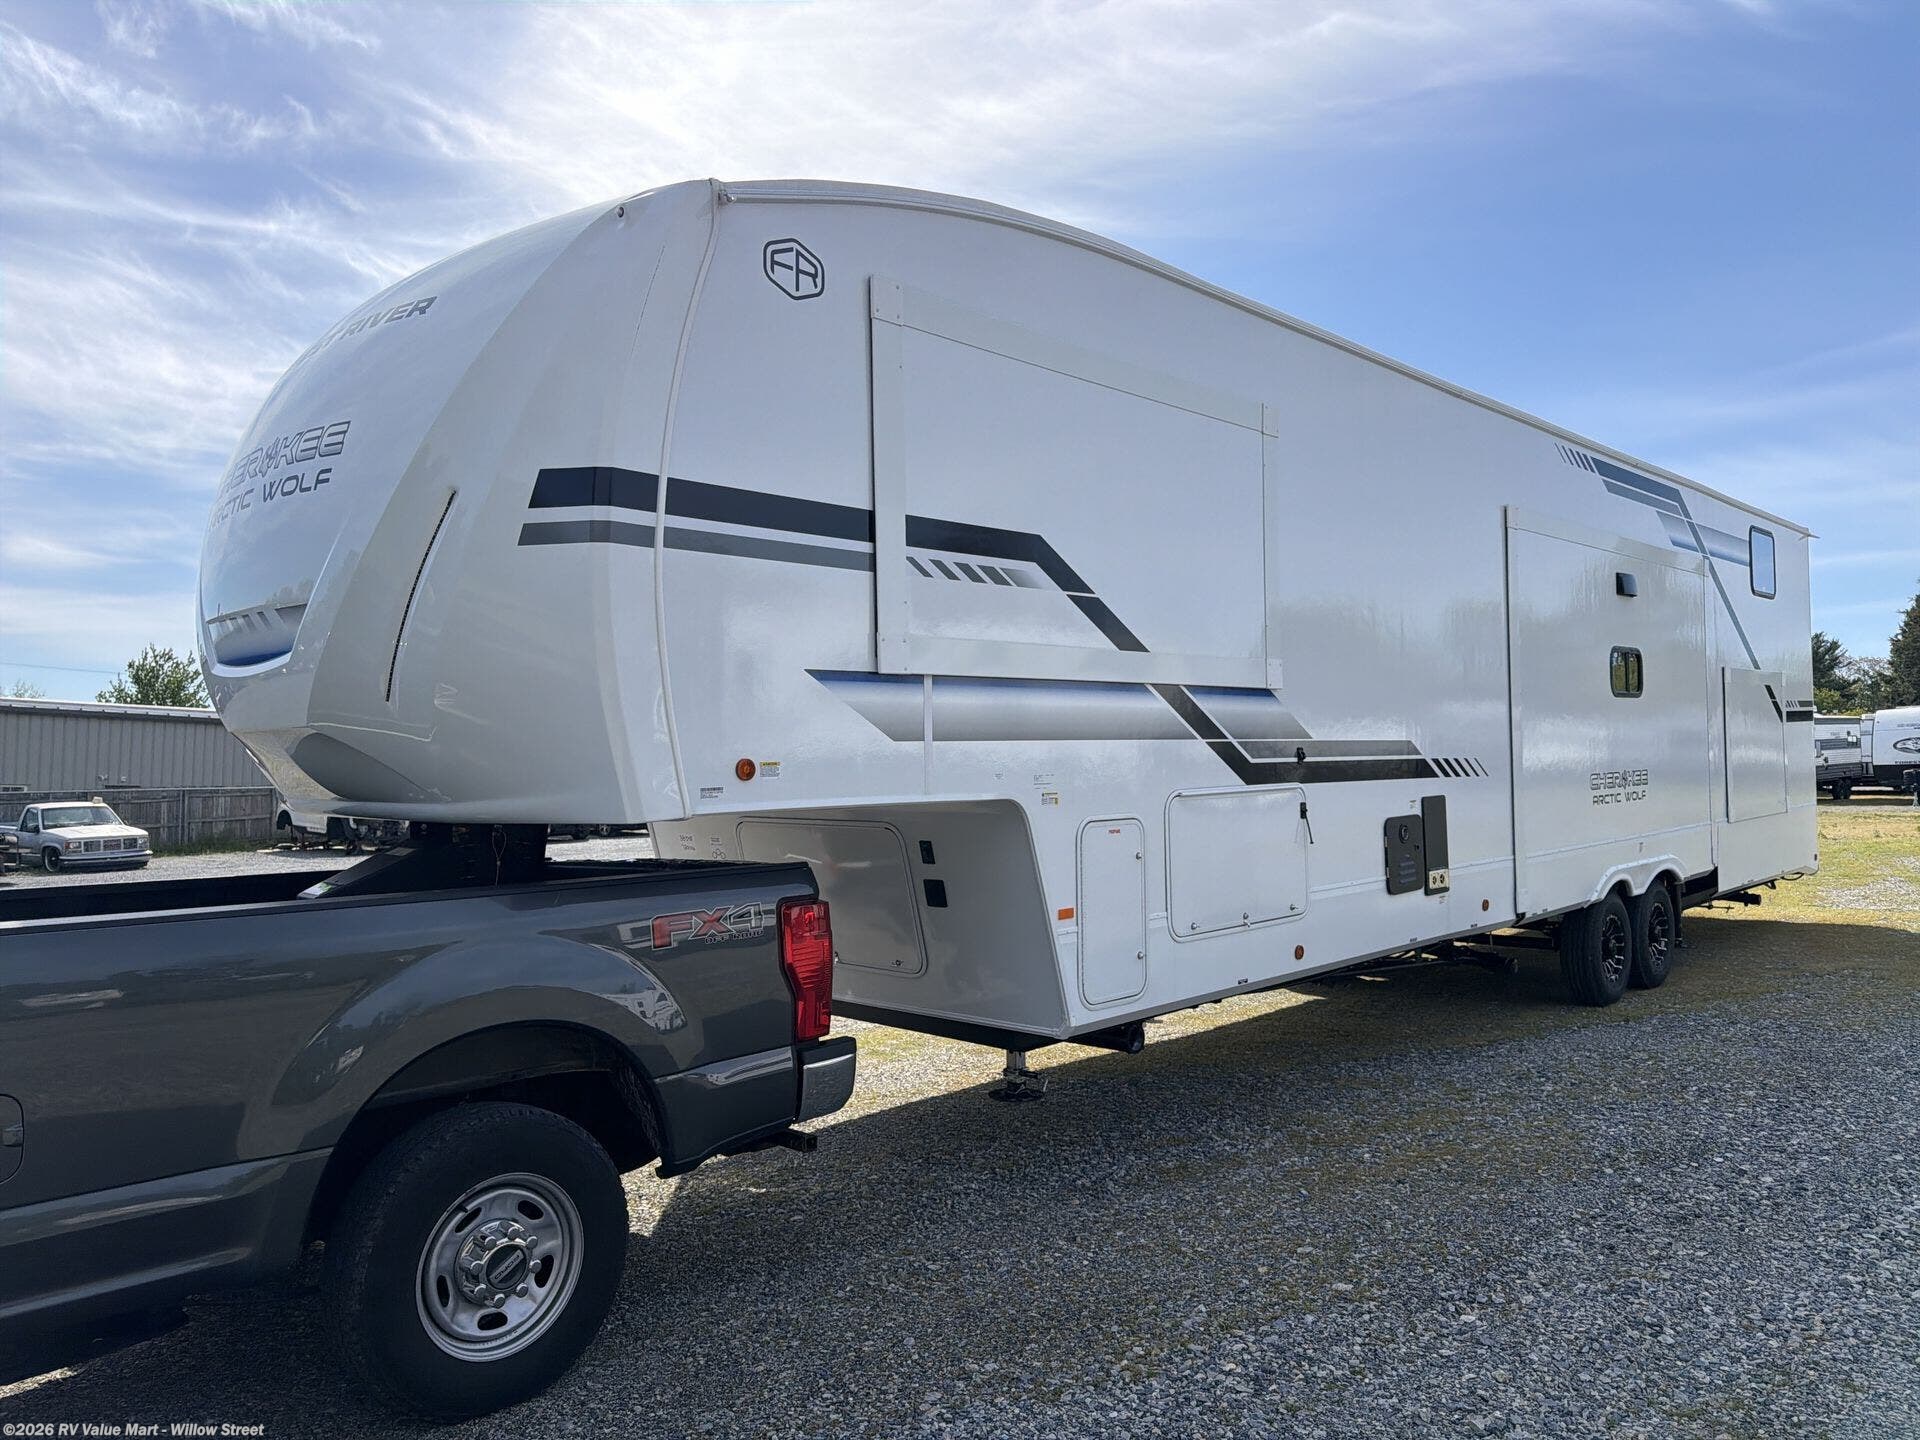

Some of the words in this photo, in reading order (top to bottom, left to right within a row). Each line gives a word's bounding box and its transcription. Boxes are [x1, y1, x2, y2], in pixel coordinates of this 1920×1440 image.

[769, 246, 819, 292] FR
[340, 296, 438, 340] RIVER
[222, 420, 351, 492] EROKEE
[263, 468, 333, 503] WOLF
[1592, 792, 1622, 806] ARCTIC
[1624, 790, 1647, 802] WOLF
[650, 902, 764, 950] FX4
